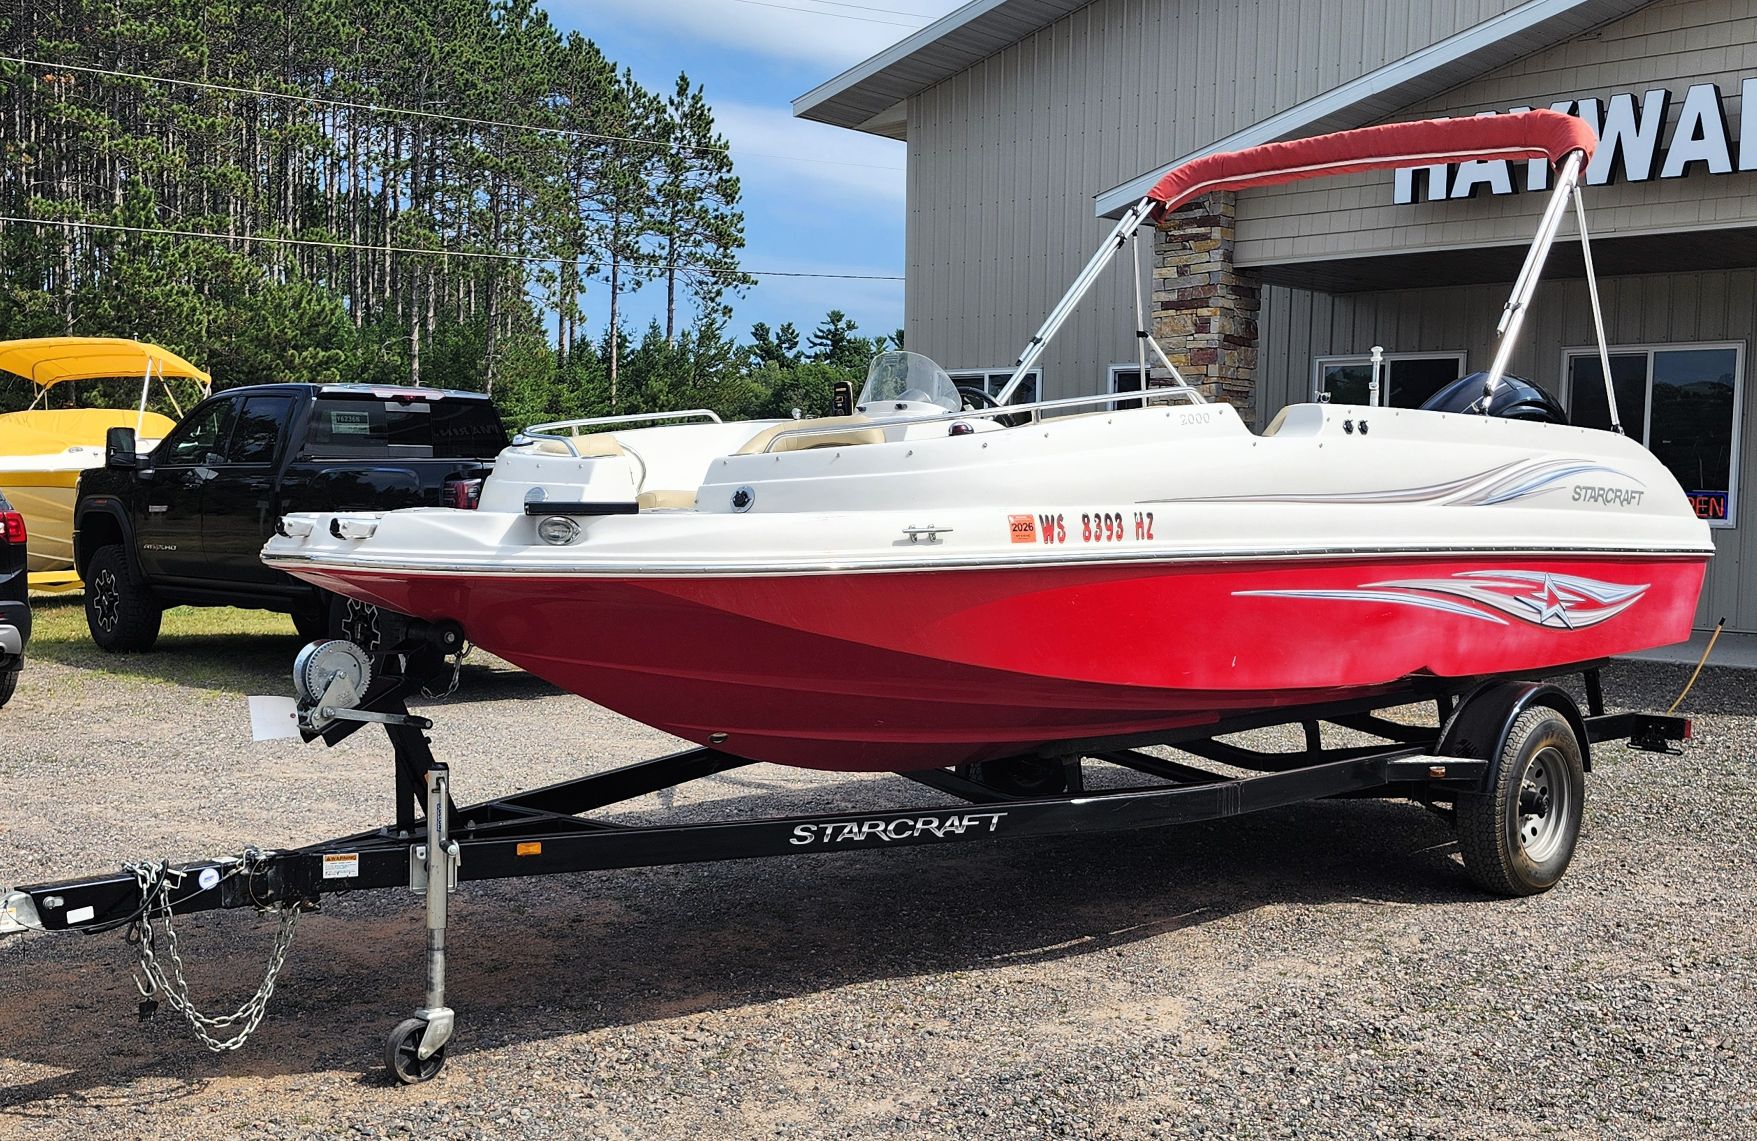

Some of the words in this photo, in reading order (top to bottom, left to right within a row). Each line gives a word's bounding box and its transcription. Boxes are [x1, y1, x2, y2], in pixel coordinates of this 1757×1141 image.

[1394, 76, 1757, 204] AWA
[1180, 412, 1210, 426] 2000
[1571, 484, 1645, 507] STARCRAFT
[1688, 496, 1725, 517] EN
[1011, 522, 1034, 532] 2026
[1038, 513, 1067, 544] WS
[1081, 511, 1124, 543] 8393
[789, 812, 1009, 845] STARCRAFT
